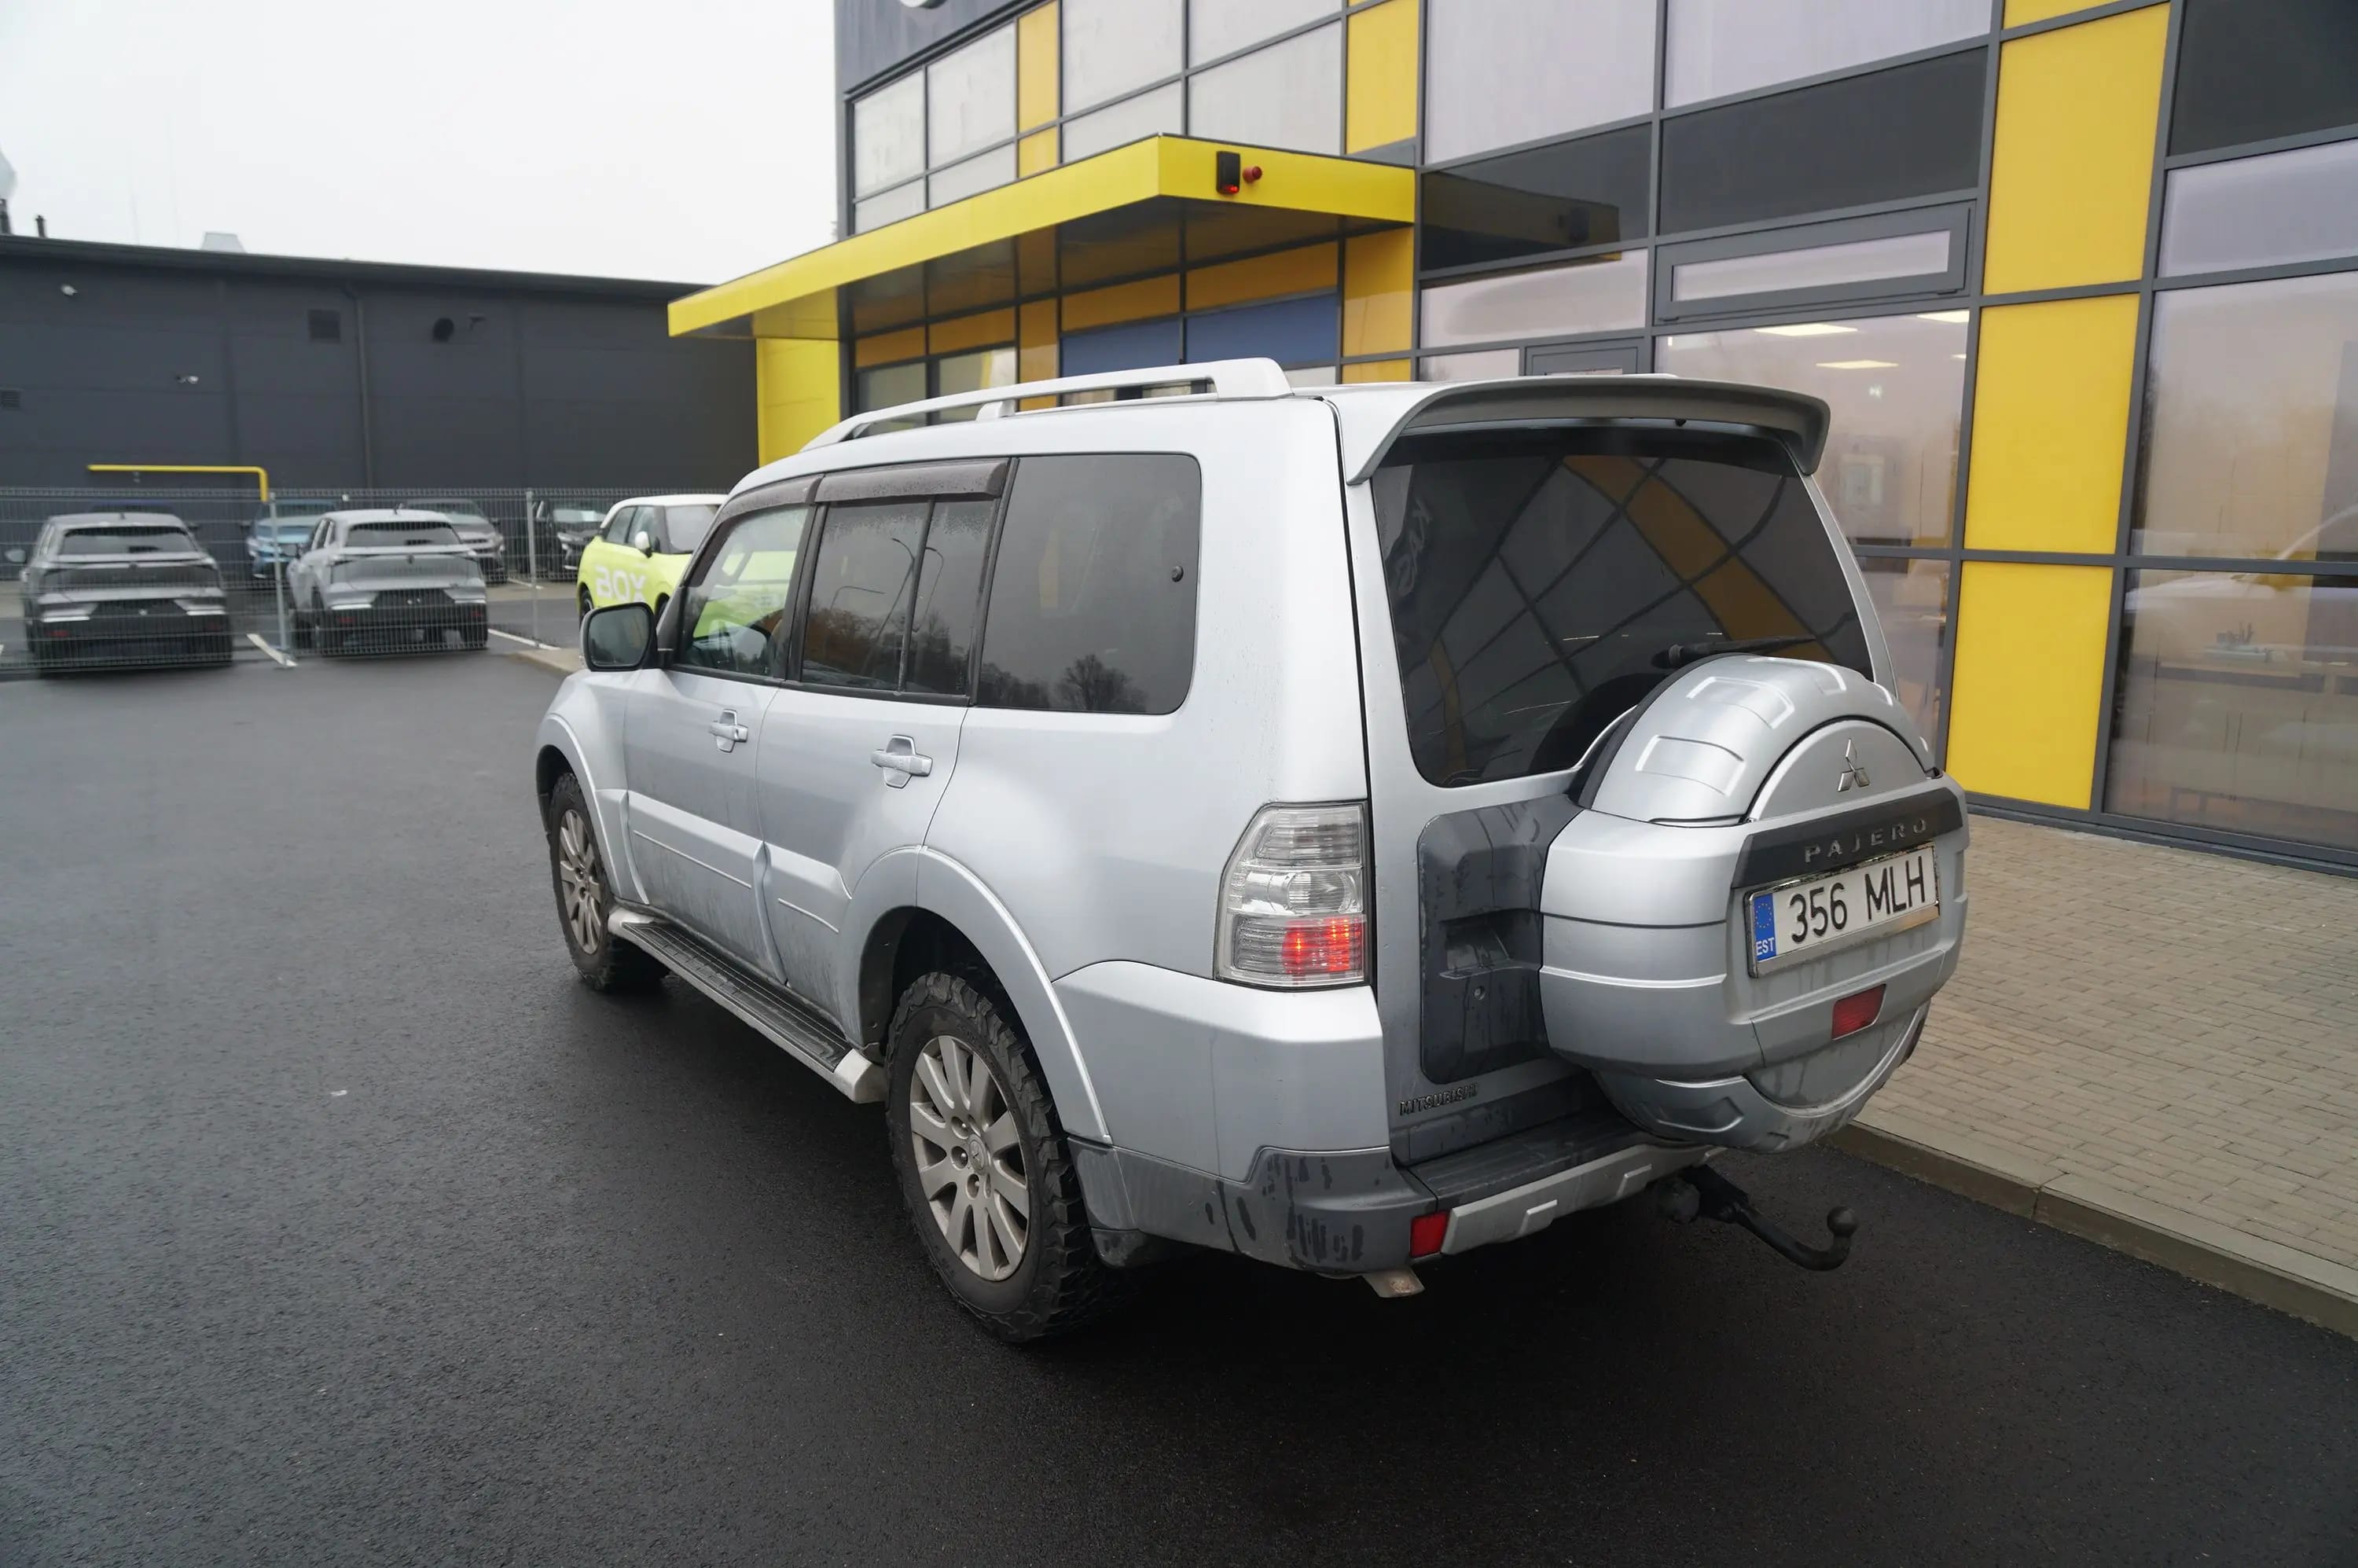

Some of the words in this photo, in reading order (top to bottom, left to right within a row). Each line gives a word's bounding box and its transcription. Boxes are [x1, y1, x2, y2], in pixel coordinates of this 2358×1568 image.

[1805, 818, 1926, 864] PAJERO
[1789, 882, 1848, 943] 356
[1864, 855, 1926, 920] MLH
[1755, 937, 1775, 957] EST
[1399, 1082, 1478, 1116] MITSUBISHI
